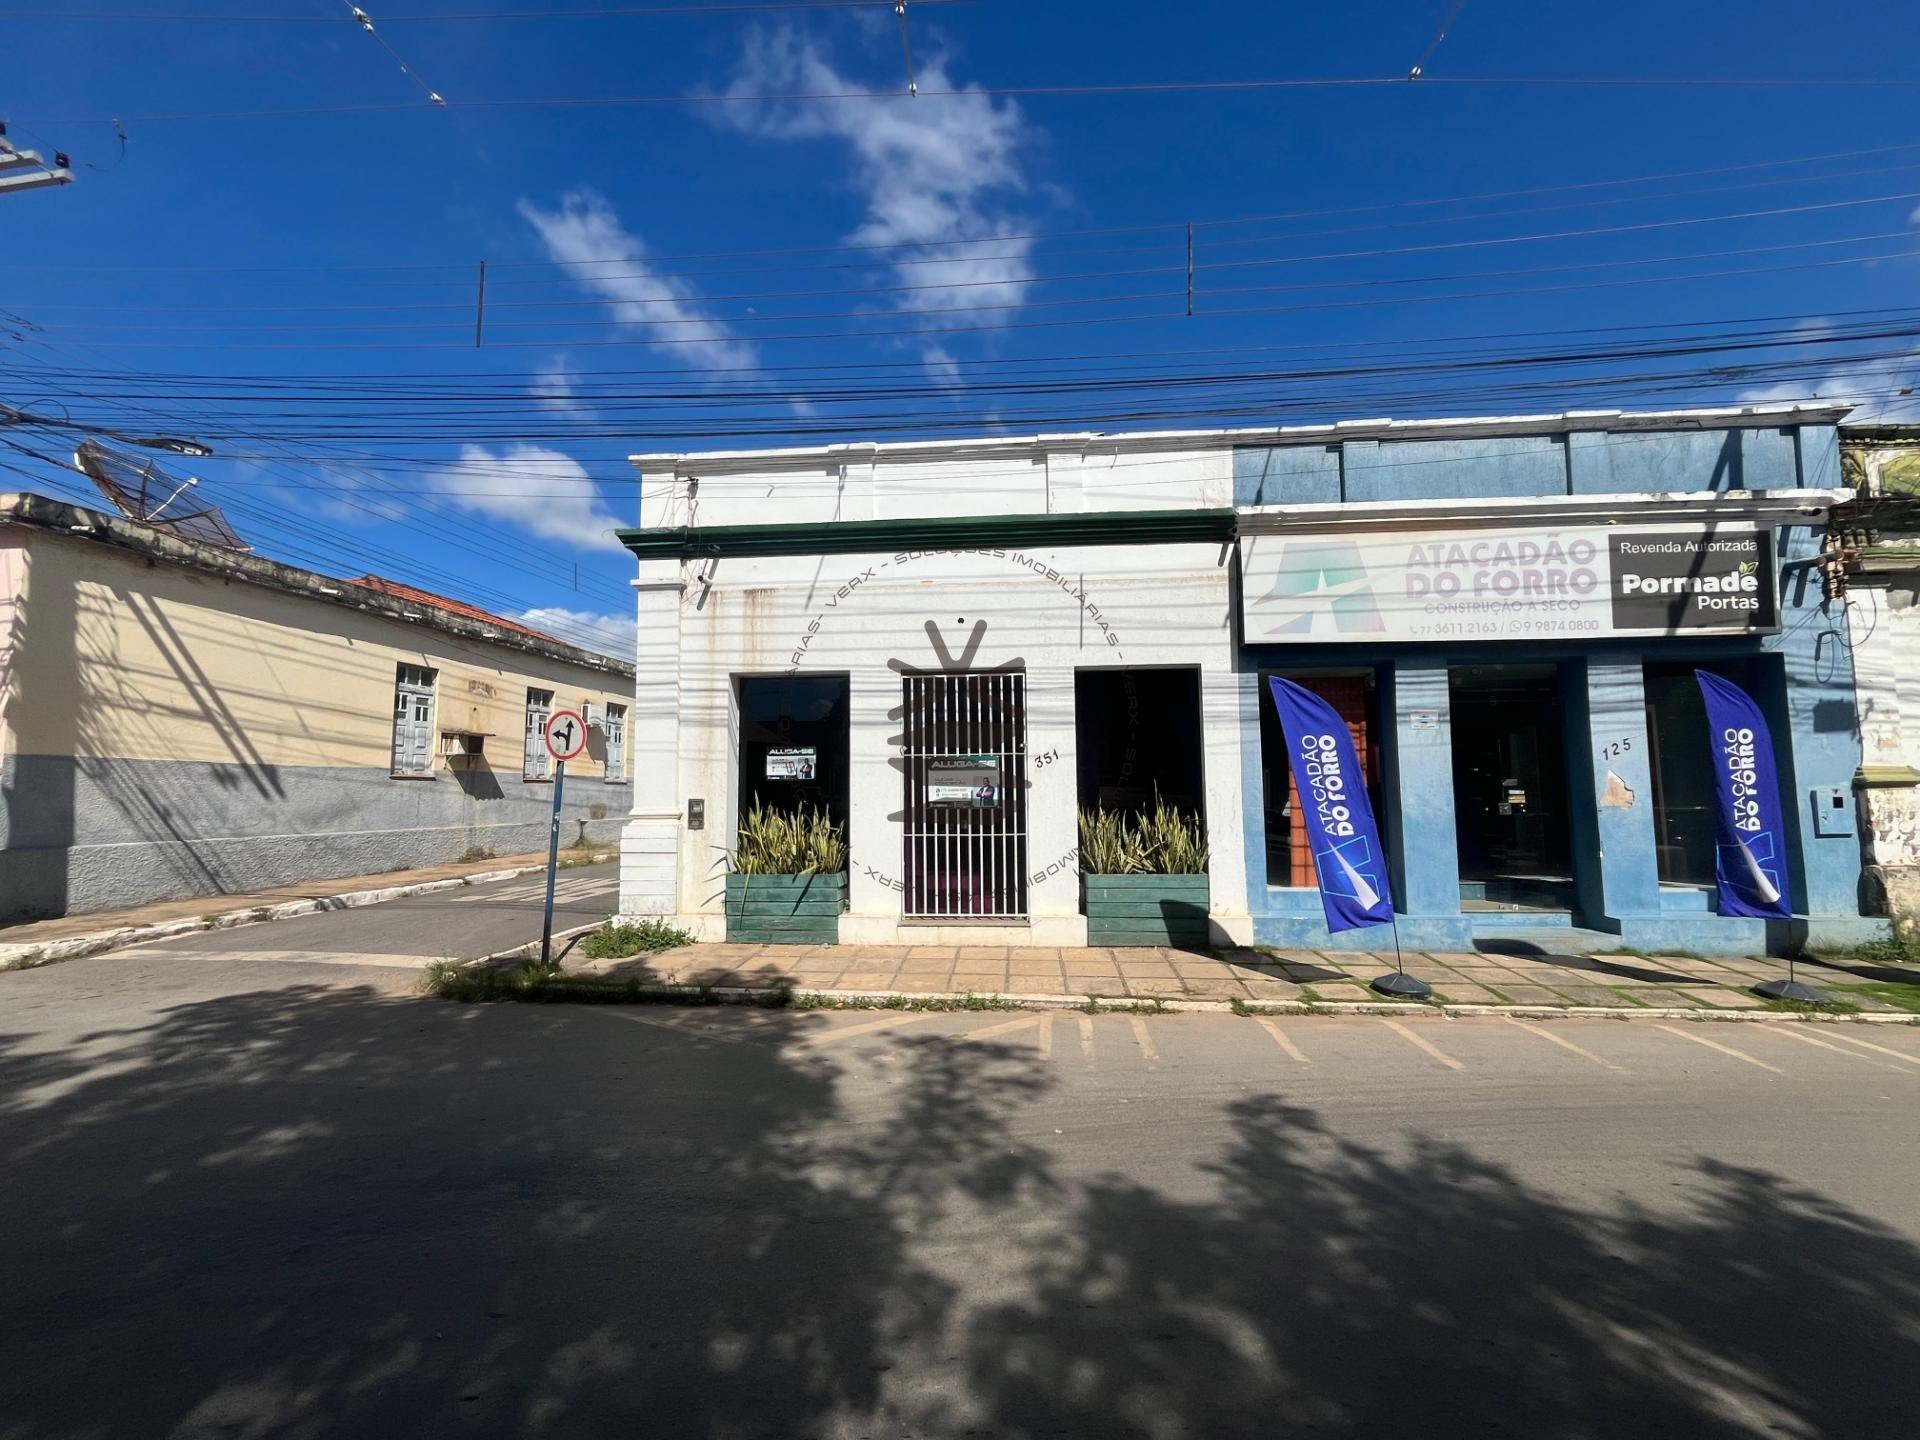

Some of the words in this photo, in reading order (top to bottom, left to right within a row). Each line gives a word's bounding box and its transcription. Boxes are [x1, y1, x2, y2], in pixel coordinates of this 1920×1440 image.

[1406, 533, 1597, 569] ATACADÃO
[1620, 541, 1682, 554] Revenda
[1684, 539, 1758, 553] Autorizada
[1405, 571, 1462, 599] DO
[1473, 567, 1598, 597] FORRO
[1622, 571, 1759, 594] Pormade
[1424, 599, 1523, 615] CONSTRUÇÃO
[1527, 600, 1537, 612] A
[1541, 599, 1581, 612] SECO
[1698, 595, 1759, 610] Portas
[1435, 622, 1497, 633] 3611.2163
[1523, 621, 1532, 632] 9
[1535, 620, 1600, 632] 9874.0800
[1034, 748, 1059, 769] 351
[1602, 737, 1631, 761] 125
[1737, 728, 1758, 795] FORRO
[1318, 734, 1347, 801] FORRO
[1724, 728, 1751, 831] ATACADÃO
[1301, 735, 1337, 836] ATACADÃO
[1327, 805, 1355, 837] DO
[1747, 805, 1761, 832] DO
